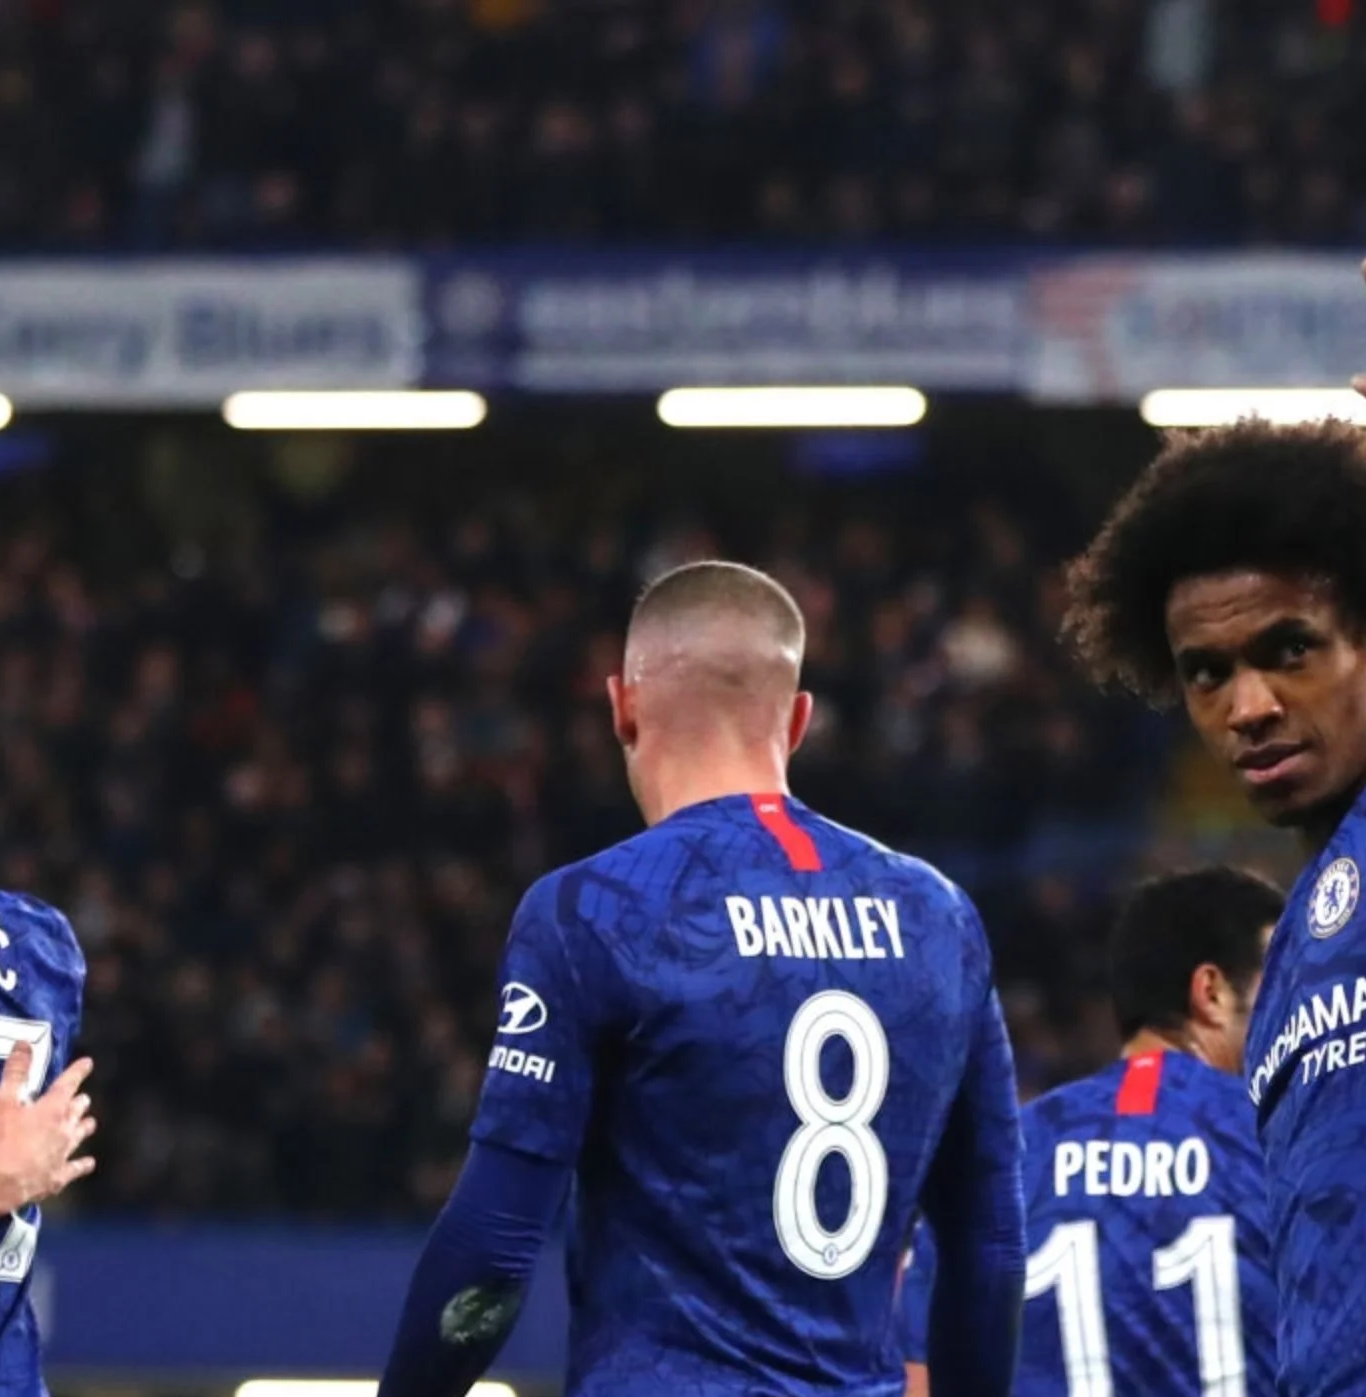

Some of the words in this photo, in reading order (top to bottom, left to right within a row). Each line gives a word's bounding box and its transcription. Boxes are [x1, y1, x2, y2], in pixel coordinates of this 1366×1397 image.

[725, 895, 905, 960] BARKLEY
[772, 988, 891, 1281] 8
[1053, 1136, 1211, 1198] PEDRO
